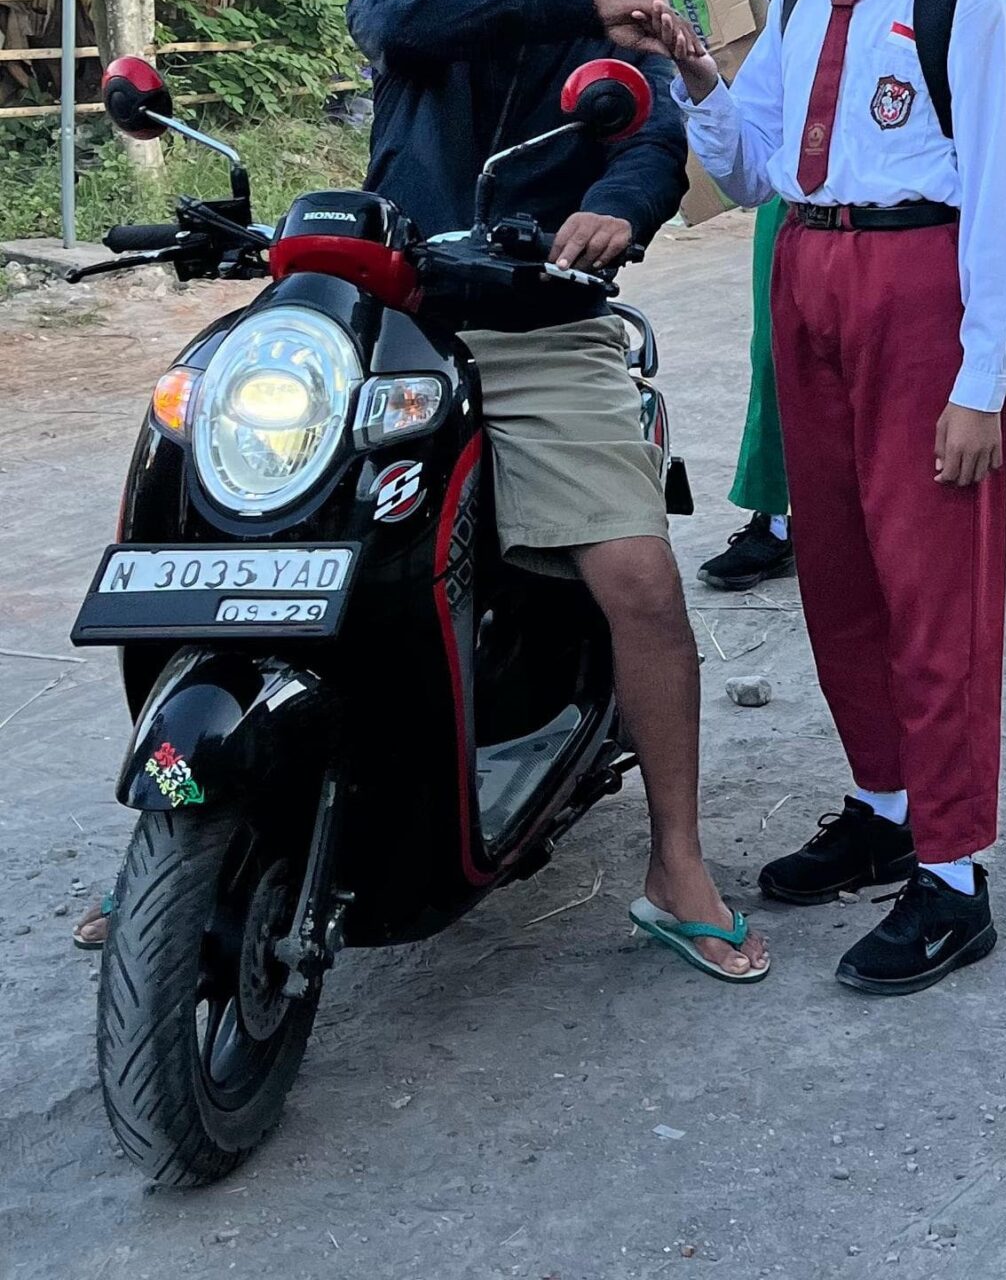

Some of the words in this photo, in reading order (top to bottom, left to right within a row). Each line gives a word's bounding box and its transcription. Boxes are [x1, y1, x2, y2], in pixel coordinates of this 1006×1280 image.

[303, 211, 357, 222] HONDA
[110, 562, 136, 590] N
[154, 559, 257, 589] 3035
[272, 559, 341, 588] YAD
